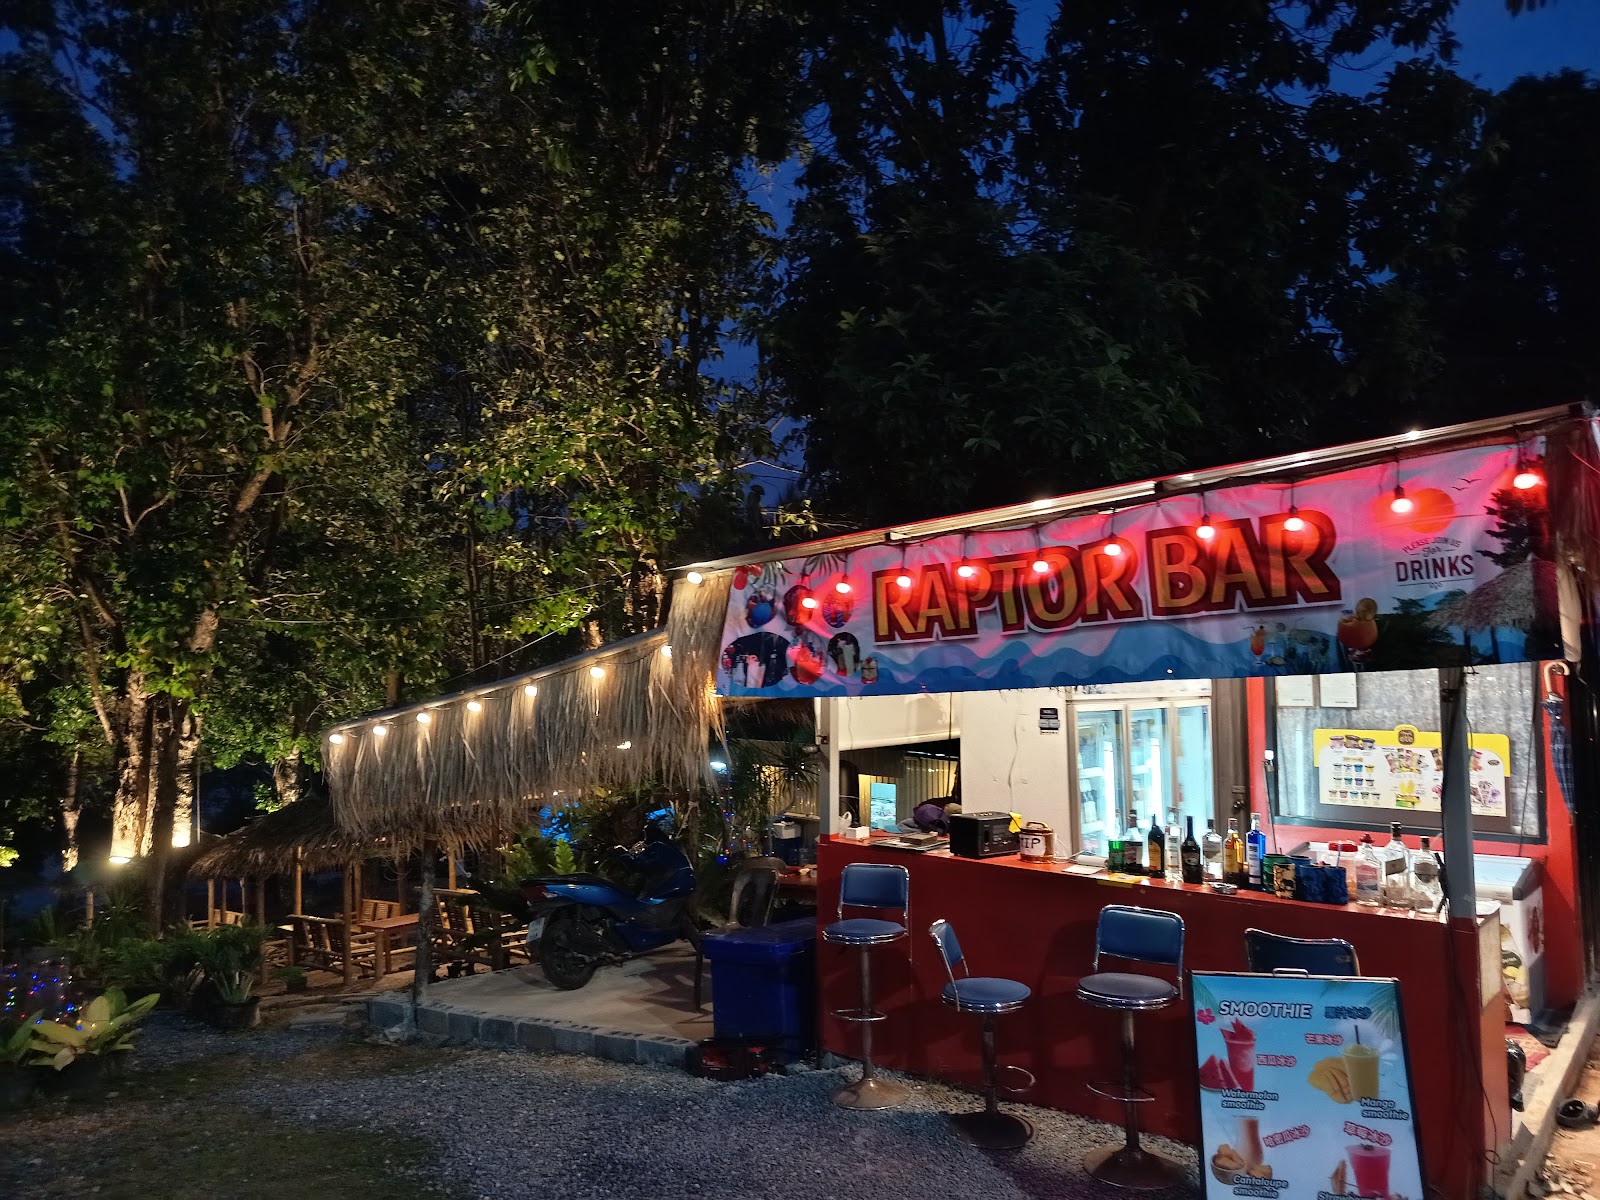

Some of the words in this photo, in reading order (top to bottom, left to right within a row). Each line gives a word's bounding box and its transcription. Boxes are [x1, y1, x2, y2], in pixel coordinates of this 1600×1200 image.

[1402, 538, 1431, 553] PLEASE
[1395, 554, 1474, 582] DRINKS
[872, 539, 1143, 644] RAPTOR
[1146, 510, 1342, 620] BAR
[1219, 1000, 1313, 1019] SMOOTHIE
[1257, 1054, 1297, 1067] 西瓜冰沙
[1221, 1088, 1279, 1101] Watermelon
[1221, 1100, 1265, 1110] smoothie
[1361, 1097, 1395, 1109] Mango
[1362, 1109, 1409, 1120] smoothie
[1263, 1125, 1311, 1148] 哈密瓜冰沙
[1344, 1121, 1392, 1146] 草莓冰沙
[1233, 1174, 1289, 1189] Cantaloupe
[1233, 1187, 1279, 1198] smoothie
